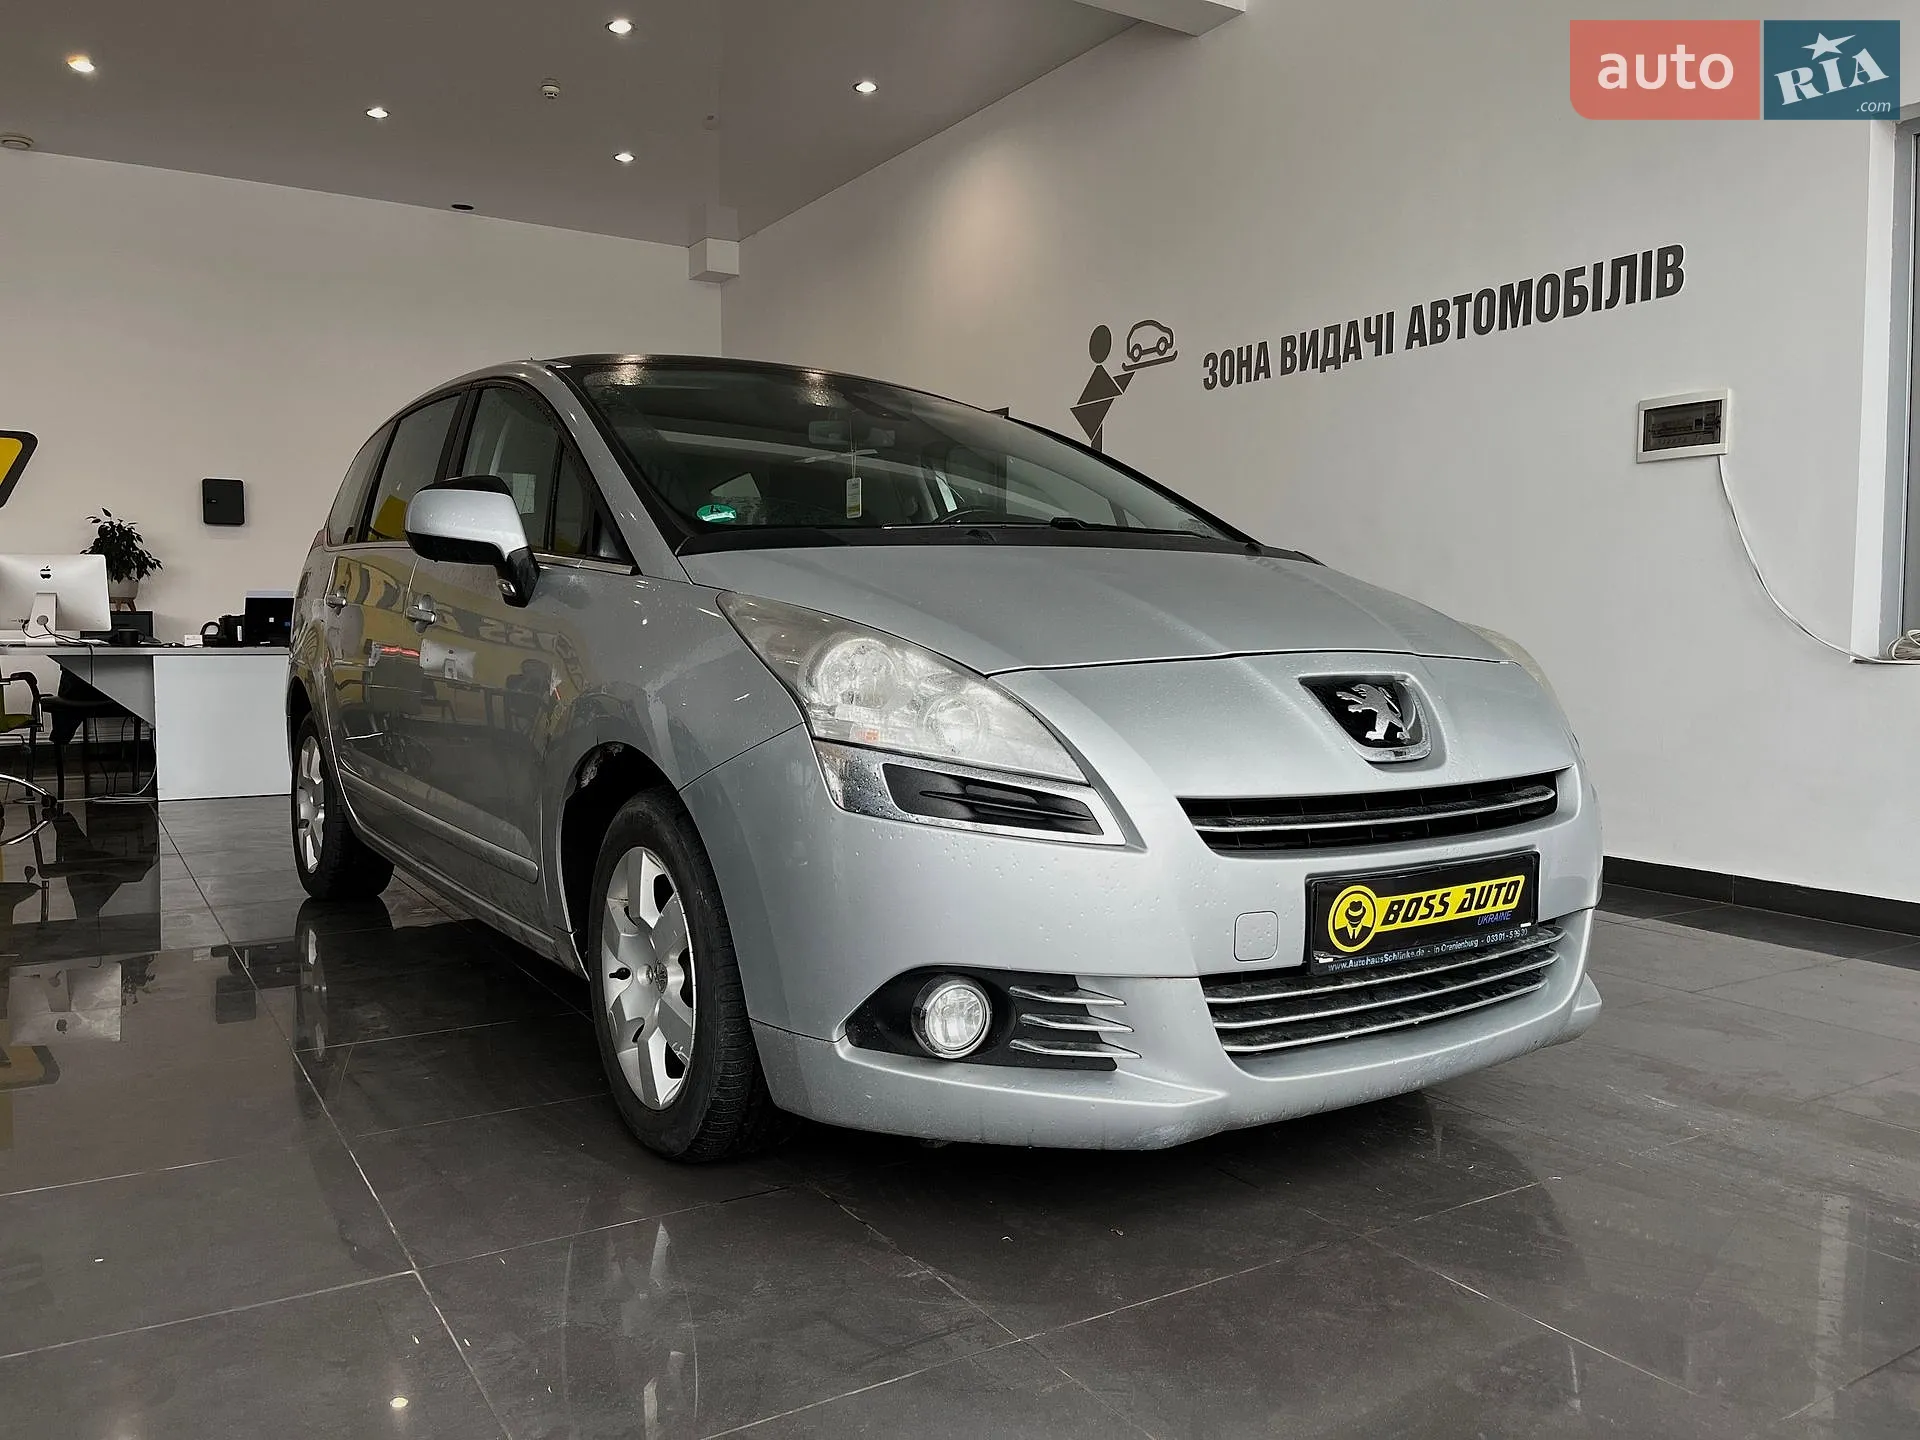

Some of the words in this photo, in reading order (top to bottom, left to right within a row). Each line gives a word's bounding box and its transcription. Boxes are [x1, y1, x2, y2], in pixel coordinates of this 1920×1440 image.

[1202, 340, 1272, 391] ЗОНА
[1280, 311, 1395, 377] ВИДАЧІ
[1405, 244, 1685, 351] АВТОМОБІЛІВ
[1380, 891, 1452, 927] BOSS
[1455, 880, 1521, 914] AUTO
[1477, 910, 1513, 926] UKRAINE
